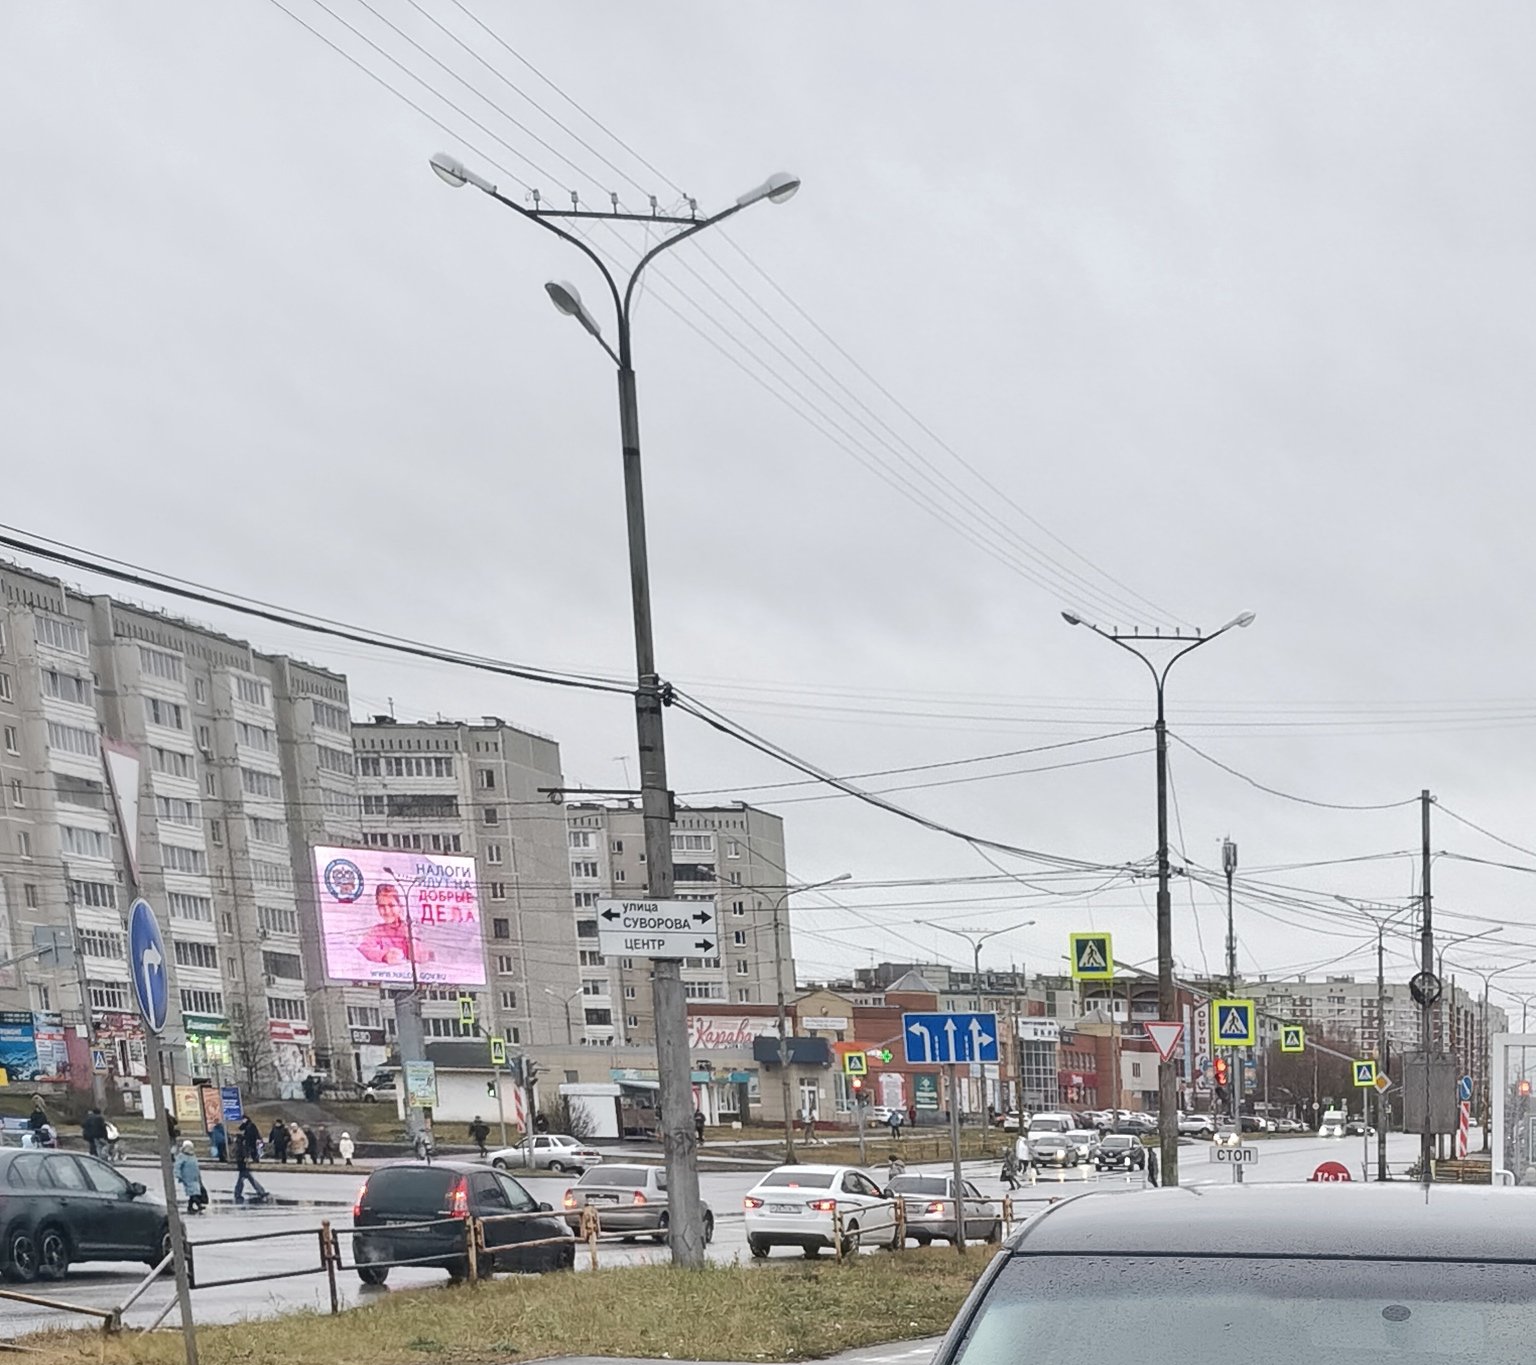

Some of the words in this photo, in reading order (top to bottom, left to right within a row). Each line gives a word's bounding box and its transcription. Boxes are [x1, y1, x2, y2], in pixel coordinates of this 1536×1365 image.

[416, 863, 471, 878] НАЛОГИ
[419, 889, 473, 903] ДОБРЫЕ
[622, 902, 659, 914] улица
[623, 917, 692, 930] СУВОРОВА
[624, 938, 665, 951] ЦЕНТР
[693, 1017, 761, 1049] Карава
[1217, 1149, 1252, 1162] СТОП
